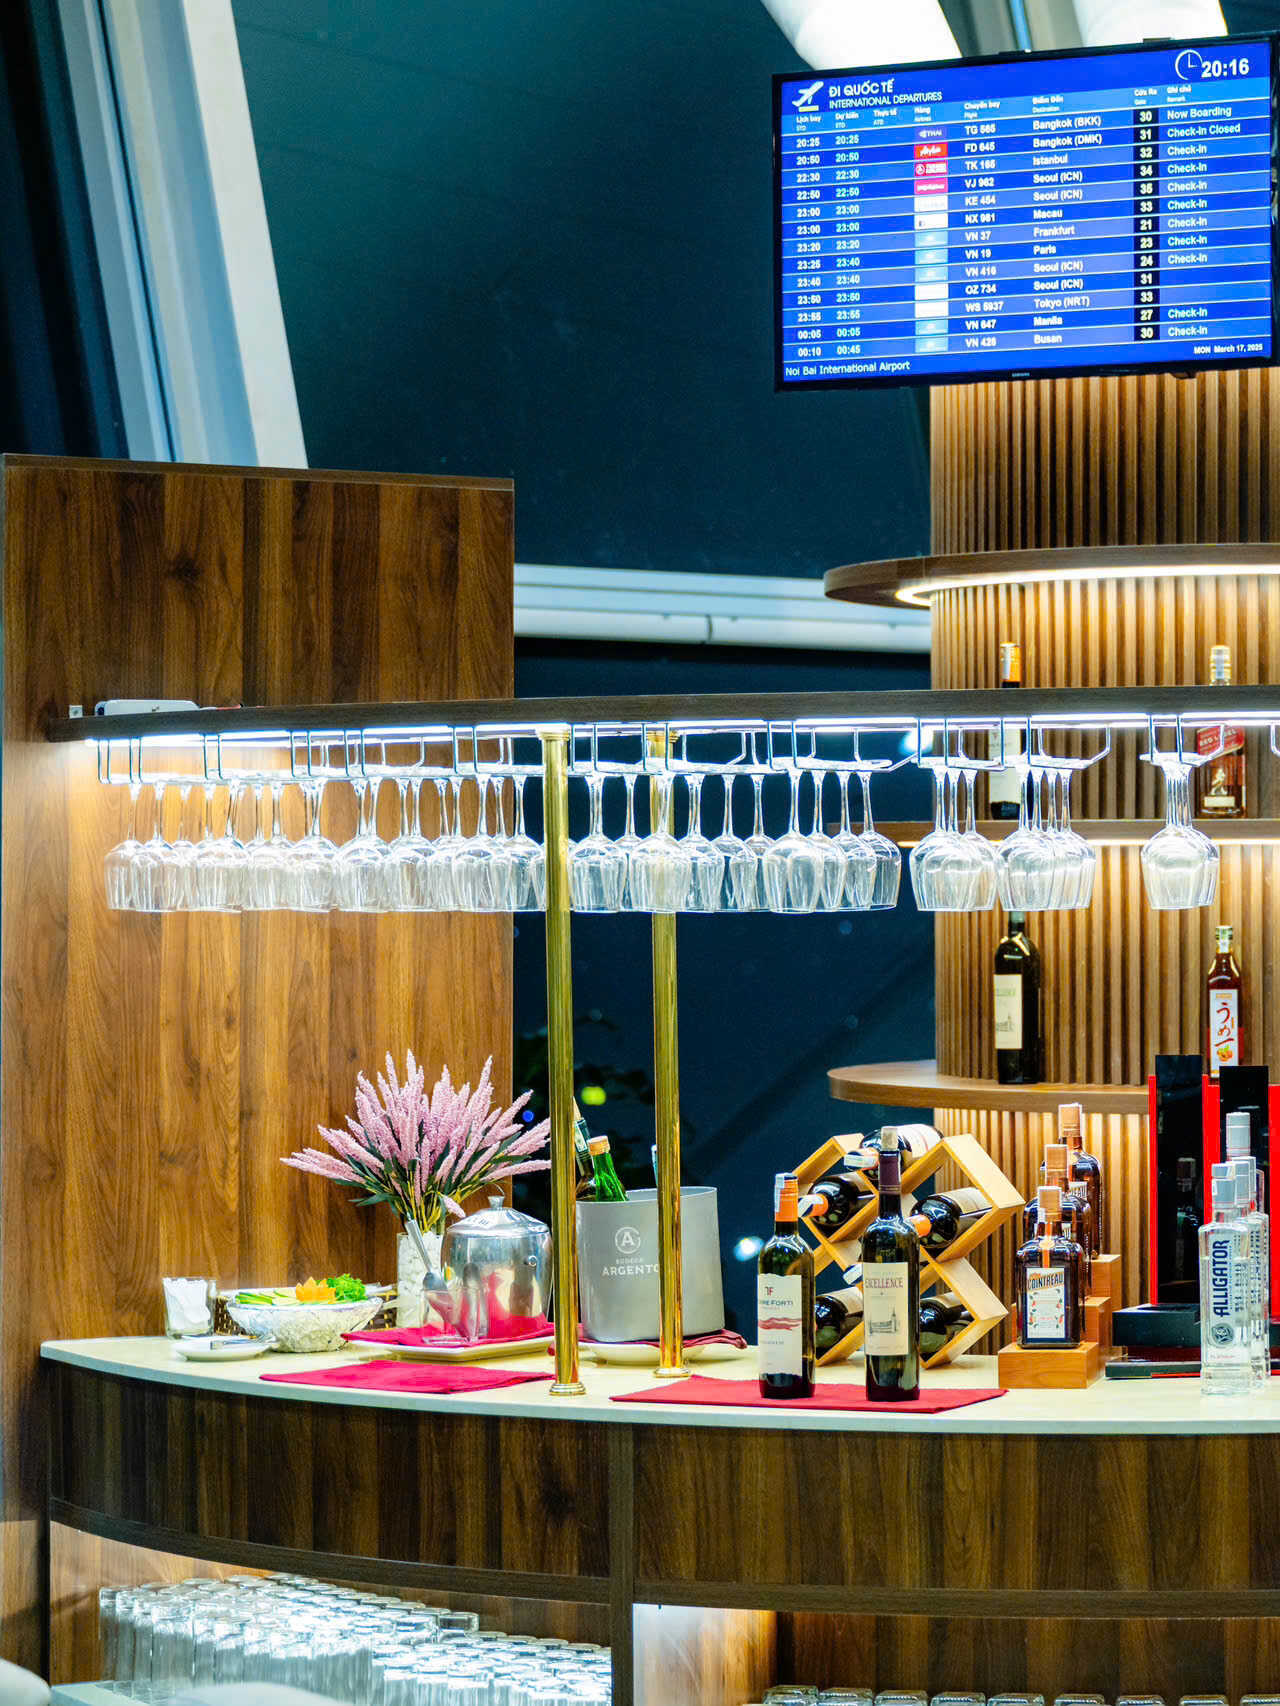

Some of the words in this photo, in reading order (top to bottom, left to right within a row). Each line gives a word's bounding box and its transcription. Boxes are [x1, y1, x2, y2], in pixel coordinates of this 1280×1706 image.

[1201, 58, 1249, 78] 20:16
[829, 86, 840, 97] ĐI
[844, 80, 880, 96] QUỐC
[881, 78, 894, 93] TẾ
[829, 96, 891, 109] INTERNATIONAL
[893, 92, 942, 104] DEPARTURES
[965, 126, 977, 135] TG
[1033, 118, 1072, 130] Bangkok
[1074, 116, 1101, 127] (BKK)
[1140, 111, 1152, 122] 30
[1167, 109, 1188, 120] Now
[1190, 107, 1232, 119] Boarding
[965, 143, 977, 153] FD
[1033, 136, 1072, 148] Bangkok
[1074, 134, 1102, 146] (DMK)
[1140, 130, 1152, 140] 31
[1209, 124, 1240, 134] Closed
[796, 172, 820, 183] 22:30
[836, 170, 860, 180] 22:30
[965, 161, 978, 170] TK
[1033, 154, 1068, 166] Istanbul
[1140, 148, 1152, 158] 32
[965, 179, 976, 188] VJ
[1033, 173, 1058, 184] Seoul
[1060, 171, 1083, 183] (ICN)
[1140, 166, 1152, 176] 34
[797, 207, 820, 218] 23:00
[836, 205, 860, 215] 23:00
[965, 196, 977, 206] KE
[1033, 191, 1058, 201] Seoul
[1060, 190, 1083, 201] (ICN)
[797, 225, 821, 235] 23:00
[836, 222, 860, 232] 23:00
[965, 214, 978, 224] NX
[1034, 210, 1062, 219] Macau
[797, 242, 821, 253] 23:20
[836, 240, 860, 250] 23:20
[965, 232, 978, 241] VN
[981, 230, 991, 240] 37
[1034, 226, 1075, 237] Frankfurt
[1140, 220, 1152, 230] 21
[836, 257, 860, 268] 23:40
[965, 250, 978, 259] VN
[1034, 245, 1056, 255] Paris
[1140, 238, 1153, 248] 23
[797, 277, 821, 288] 23:40
[836, 275, 860, 285] 23:40
[965, 267, 978, 277] VN
[1034, 262, 1058, 273] Seoul
[1061, 261, 1083, 272] (ICN)
[1140, 256, 1153, 266] 24
[1034, 280, 1058, 291] Seoul
[1061, 279, 1083, 289] (ICN)
[1140, 274, 1153, 284] 31
[965, 303, 980, 312] WS
[1034, 298, 1062, 310] Tokyo
[1064, 296, 1090, 308] (NRT)
[965, 320, 978, 330] VN
[1034, 316, 1062, 326] Manila
[1140, 310, 1153, 320] 27
[798, 347, 821, 357] 00:10
[837, 345, 861, 355] 00:45
[965, 338, 978, 347] VN
[1034, 334, 1062, 344] Busan
[1214, 344, 1235, 353] March
[786, 368, 800, 376] Noi
[803, 365, 816, 375] Bai
[820, 362, 877, 374] International
[880, 361, 910, 372] Airport
[1028, 1273, 1064, 1290] COINTREAU
[1212, 1239, 1231, 1318] ALLIGATOR
